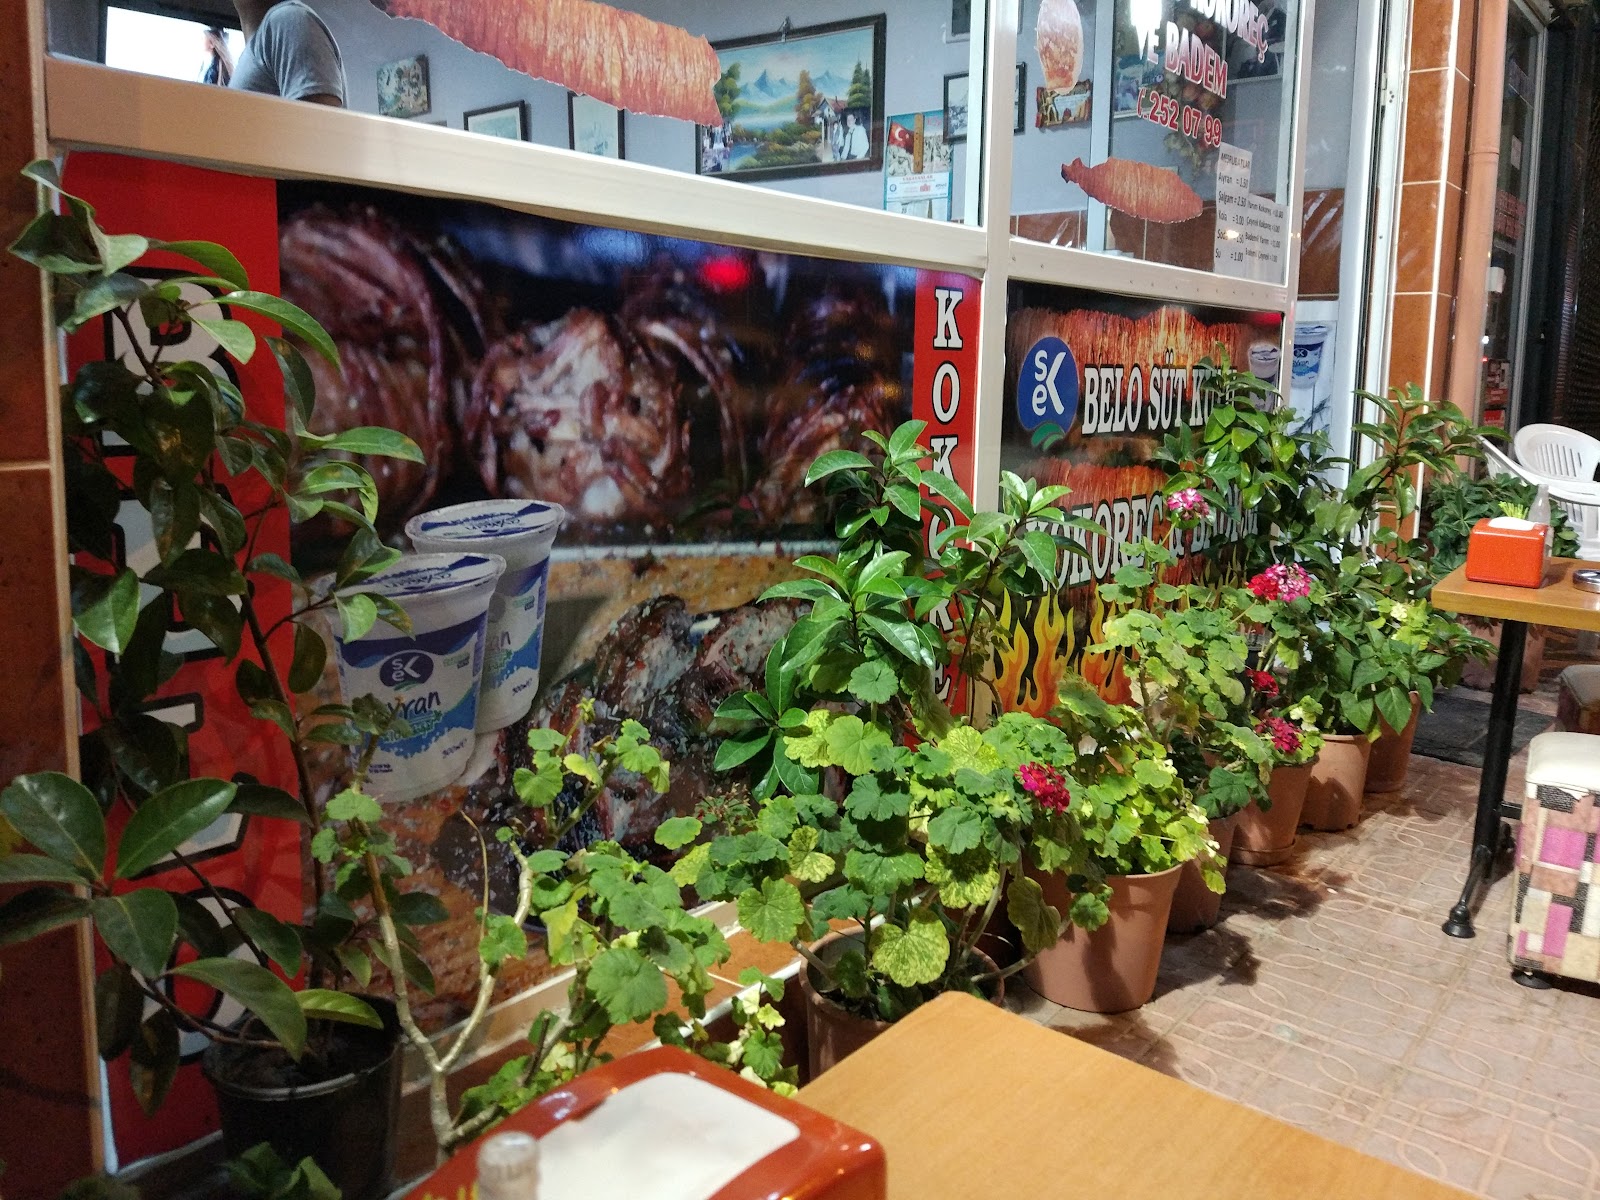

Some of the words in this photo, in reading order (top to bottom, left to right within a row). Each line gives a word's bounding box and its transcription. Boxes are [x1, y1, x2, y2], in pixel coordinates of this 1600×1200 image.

[1165, 21, 1228, 99] BADEM
[1190, 0, 1268, 63] KOREÇ
[1149, 90, 1179, 131] 252
[1182, 105, 1201, 139] 07
[1204, 115, 1223, 148] 99
[1082, 366, 1142, 435] BELO
[1148, 351, 1187, 431] SÜT
